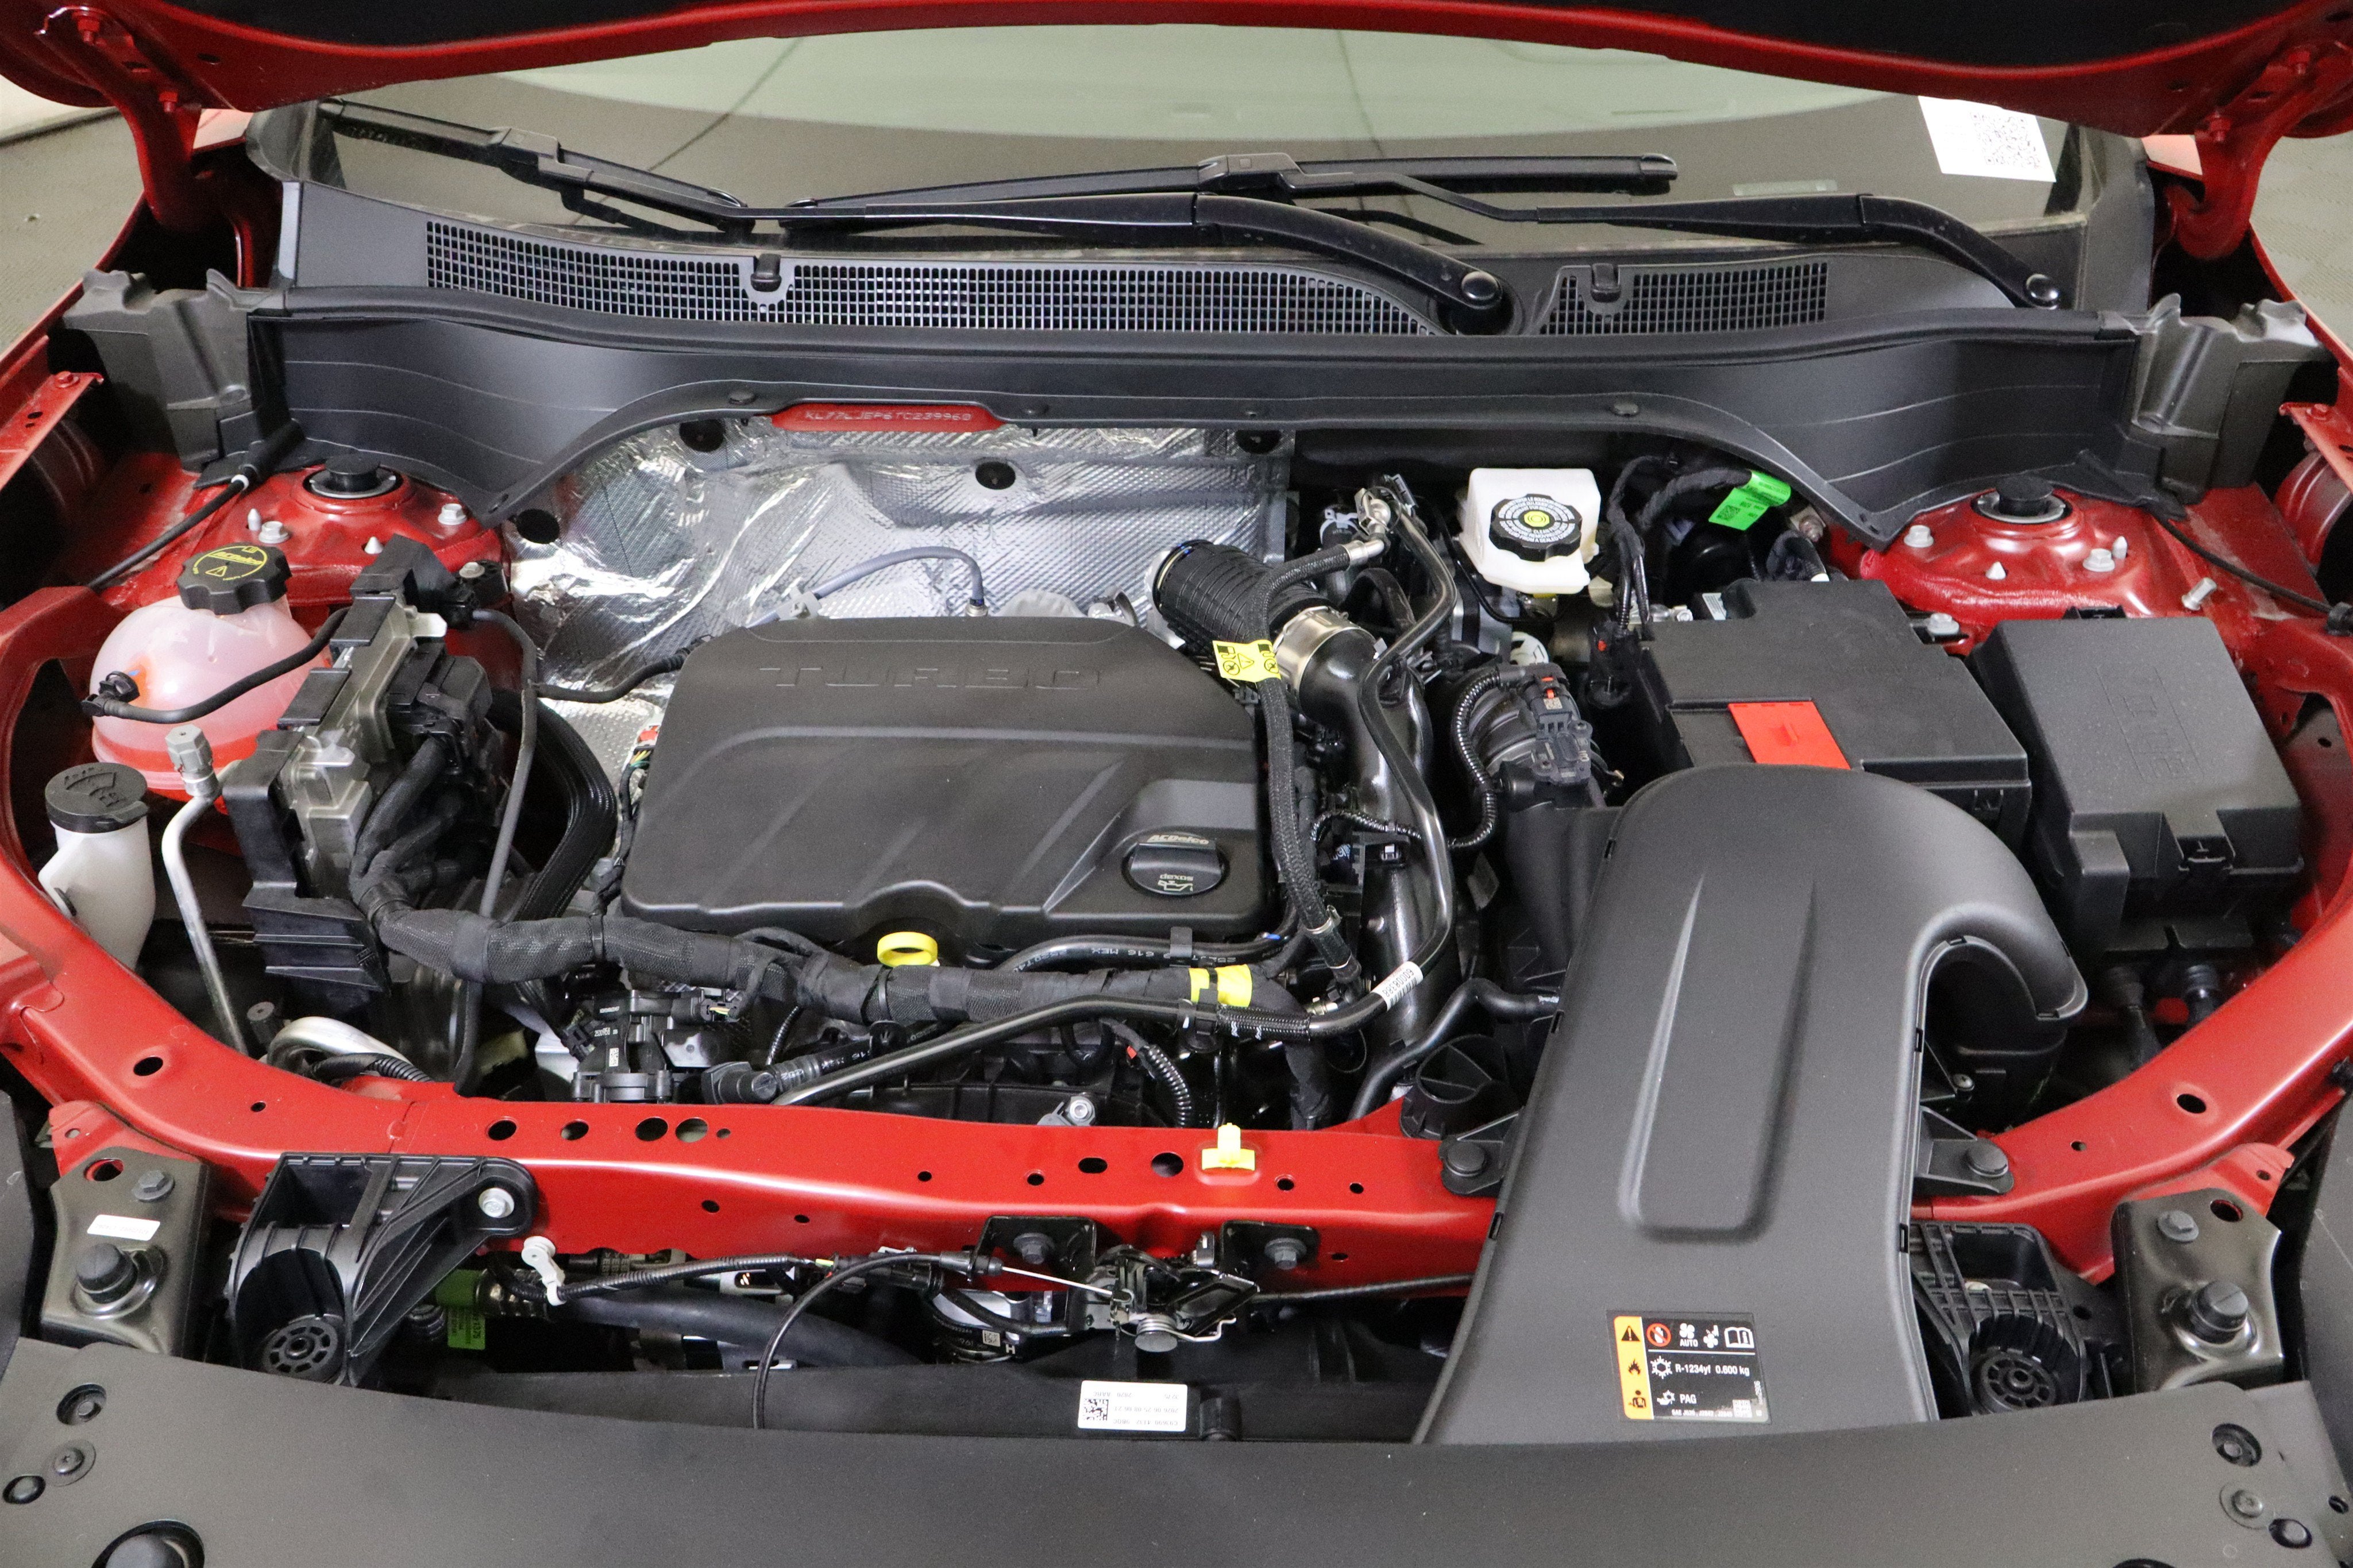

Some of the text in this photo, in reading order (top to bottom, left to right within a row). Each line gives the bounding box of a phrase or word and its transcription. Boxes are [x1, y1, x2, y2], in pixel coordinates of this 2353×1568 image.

[758, 667, 1100, 689] TURBO
[1147, 835, 1209, 845] ACDelco
[1160, 874, 1194, 882] dexos
[1680, 1339, 1698, 1347] AUTO
[1675, 1364, 1750, 1377] R-1234yf 0.600 kg
[1680, 1394, 1697, 1404] PAG
